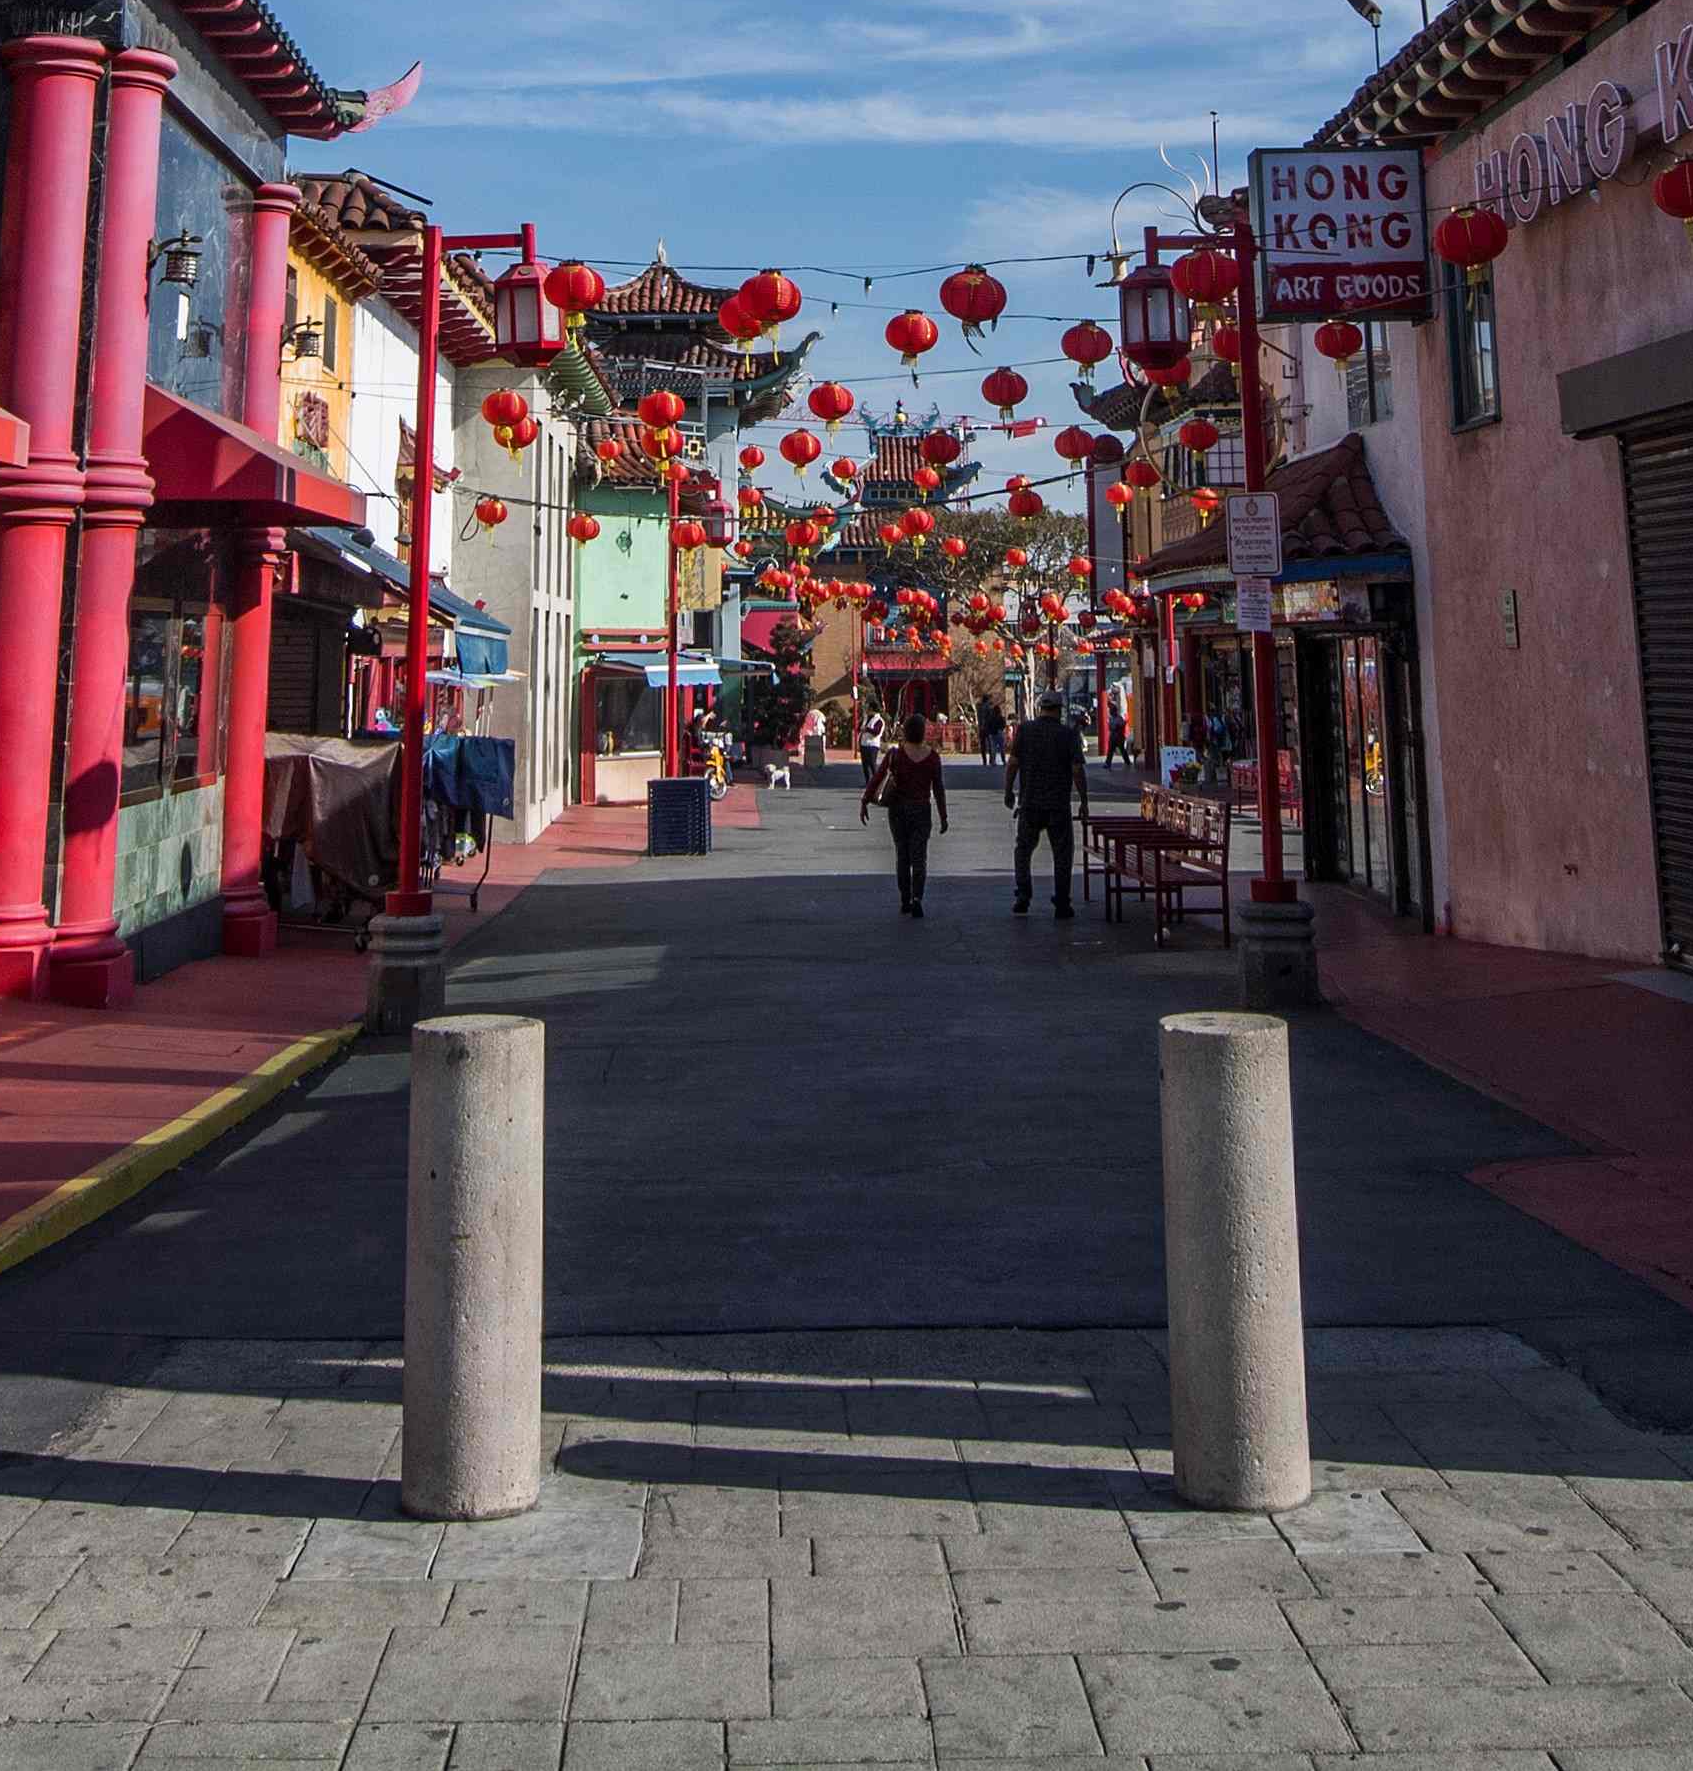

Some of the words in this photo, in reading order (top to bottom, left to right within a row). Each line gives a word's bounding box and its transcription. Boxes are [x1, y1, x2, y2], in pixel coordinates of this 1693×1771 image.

[1475, 81, 1631, 223] HONG
[1271, 164, 1408, 201] HONG
[1273, 212, 1412, 250] KONG
[1275, 276, 1324, 301] ART
[1336, 275, 1421, 300] GOODS
